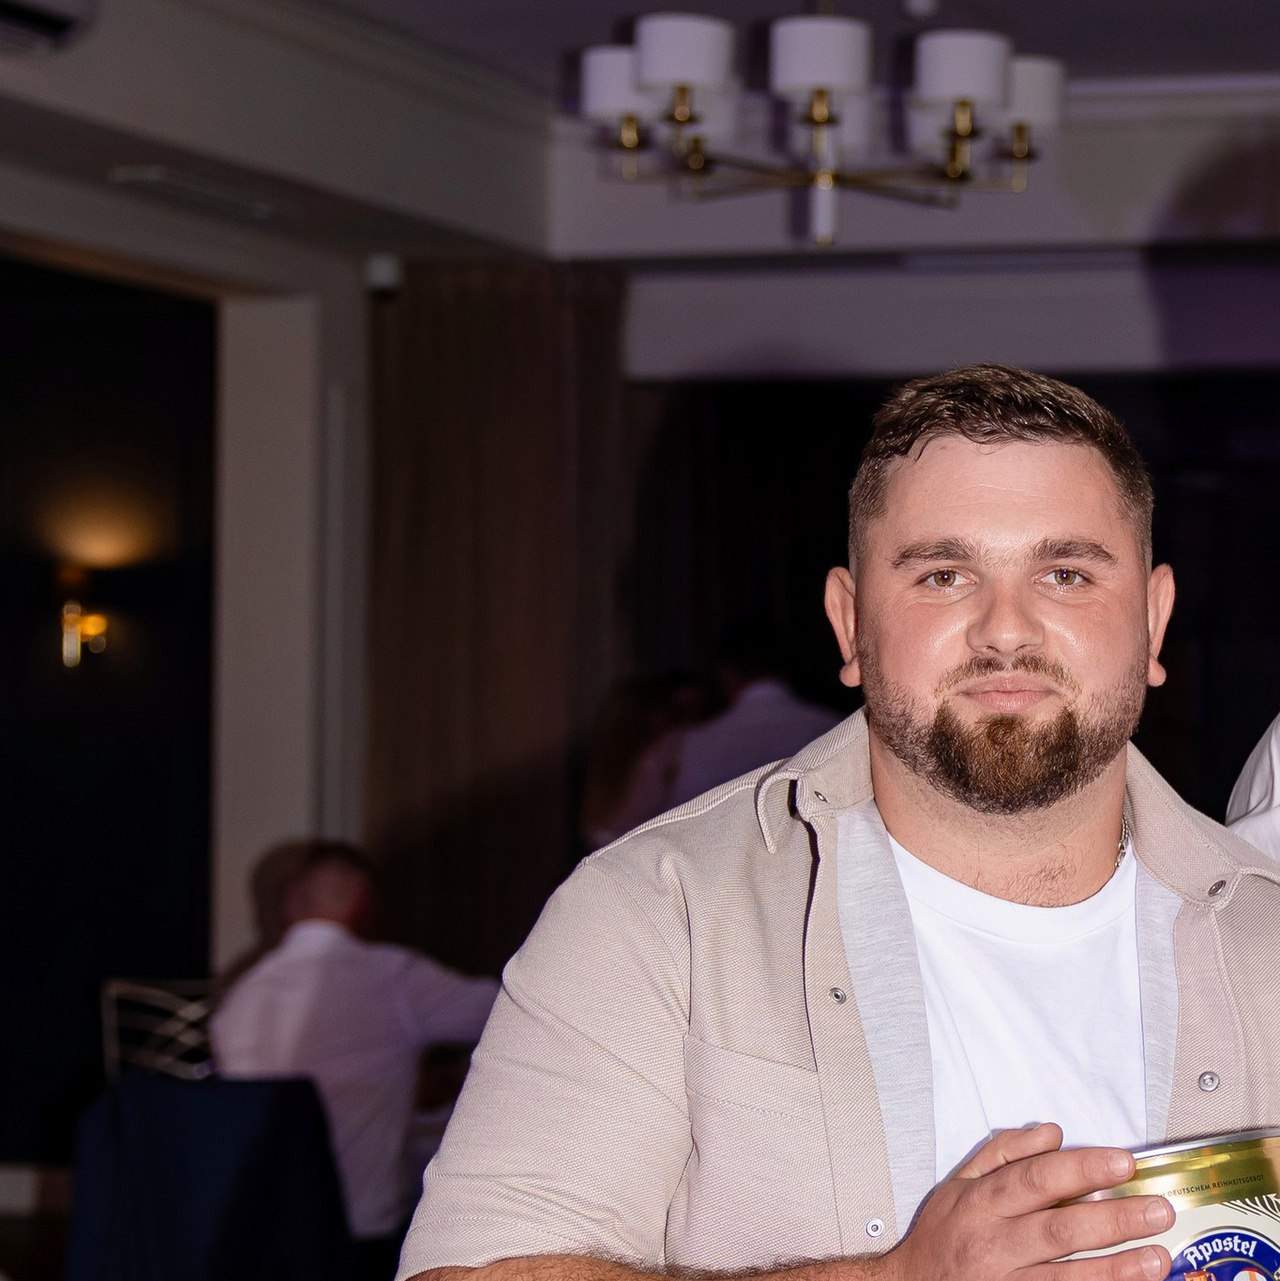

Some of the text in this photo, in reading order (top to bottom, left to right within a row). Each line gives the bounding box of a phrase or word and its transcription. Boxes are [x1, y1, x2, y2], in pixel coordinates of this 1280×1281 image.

[1168, 1174, 1264, 1197] DEUTSCHEM REINHEITSGEBOT
[1183, 1235, 1257, 1270] Apostel
